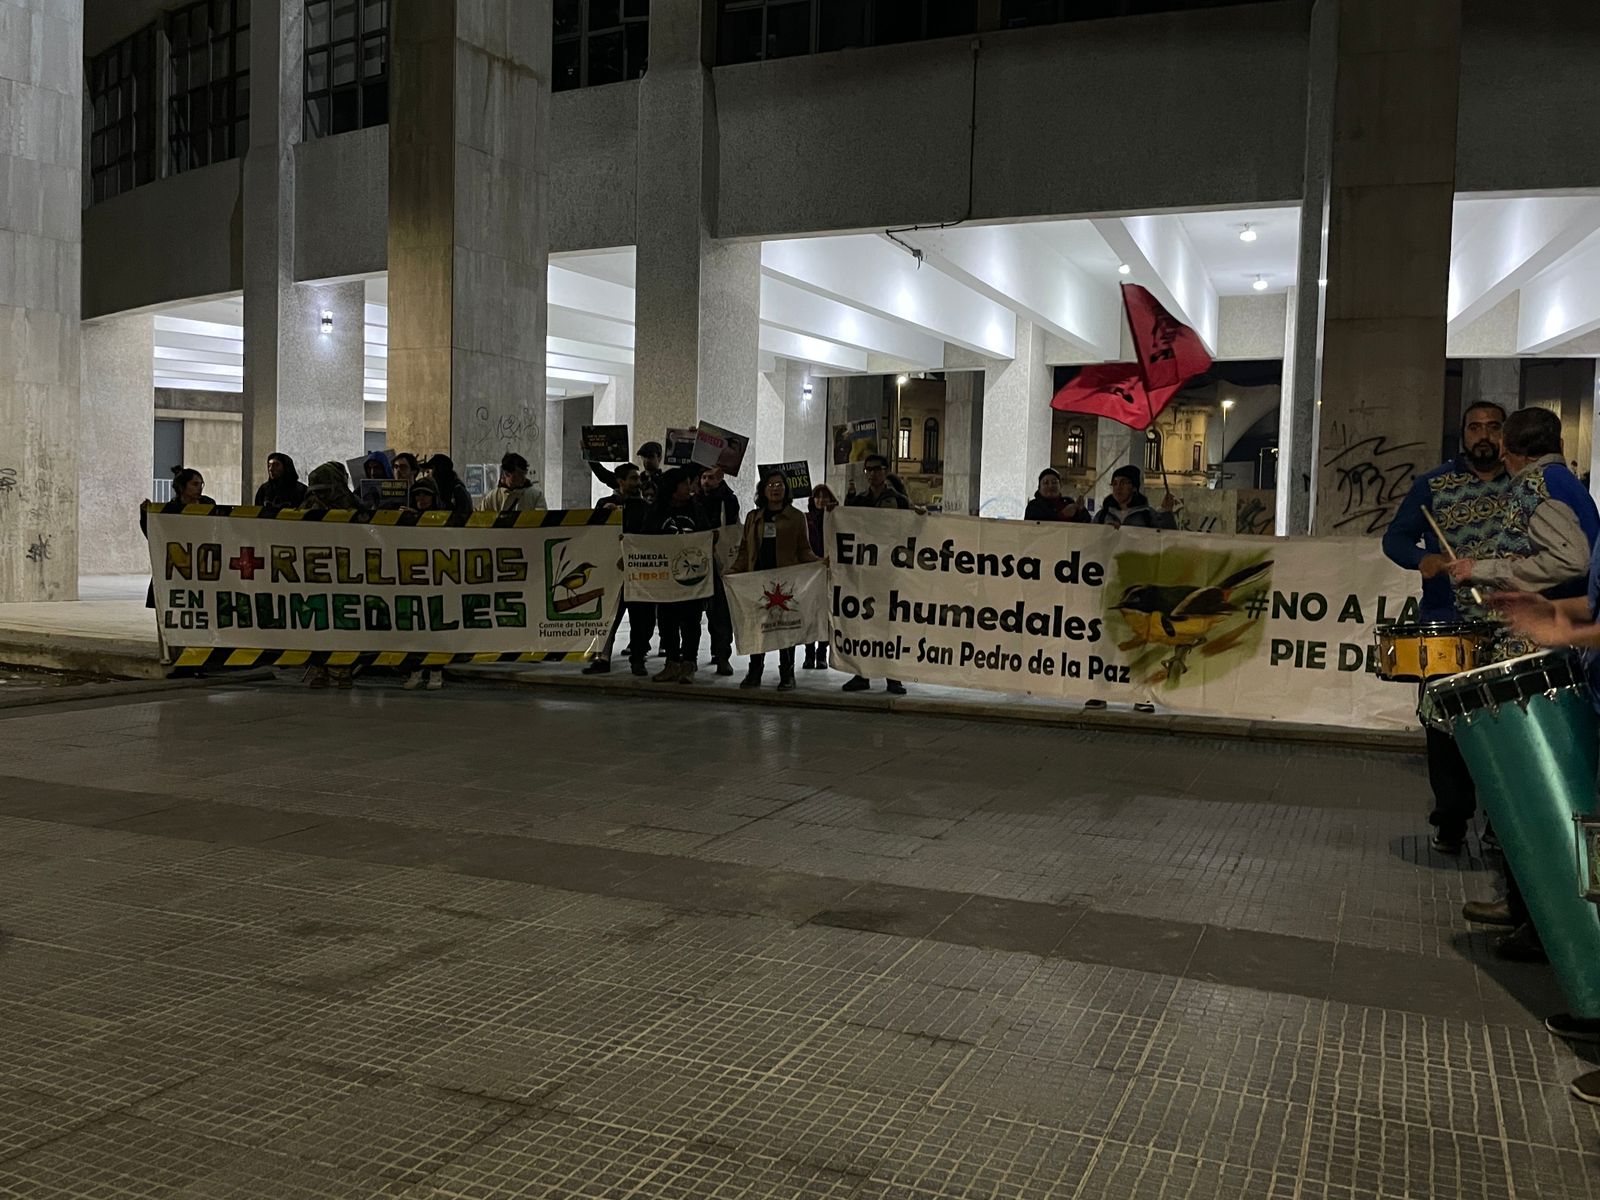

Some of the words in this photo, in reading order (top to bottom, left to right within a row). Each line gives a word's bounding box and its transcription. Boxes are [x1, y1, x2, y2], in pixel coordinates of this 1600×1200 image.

[785, 475, 809, 489] ODXS
[165, 542, 222, 582] NO
[270, 545, 529, 586] RELLENOS
[836, 532, 878, 567] En
[890, 537, 1041, 581] defensa
[1054, 550, 1105, 586] de
[170, 589, 204, 609] EN
[216, 590, 528, 632] HUMEDALES
[832, 586, 876, 620] los
[888, 590, 1103, 643] humedales
[1244, 590, 1328, 621] #NO
[1337, 594, 1364, 624] A
[1376, 595, 1420, 625] LA
[164, 609, 209, 630] LOS
[539, 627, 581, 637] Humedal
[575, 619, 603, 628] Defensa
[832, 629, 911, 660] Coronel-
[916, 637, 953, 666] San
[959, 641, 1022, 672] Pedro
[1028, 648, 1055, 676] de
[1060, 651, 1081, 678] la
[1088, 655, 1131, 684] Paz
[1270, 638, 1327, 670] PIE
